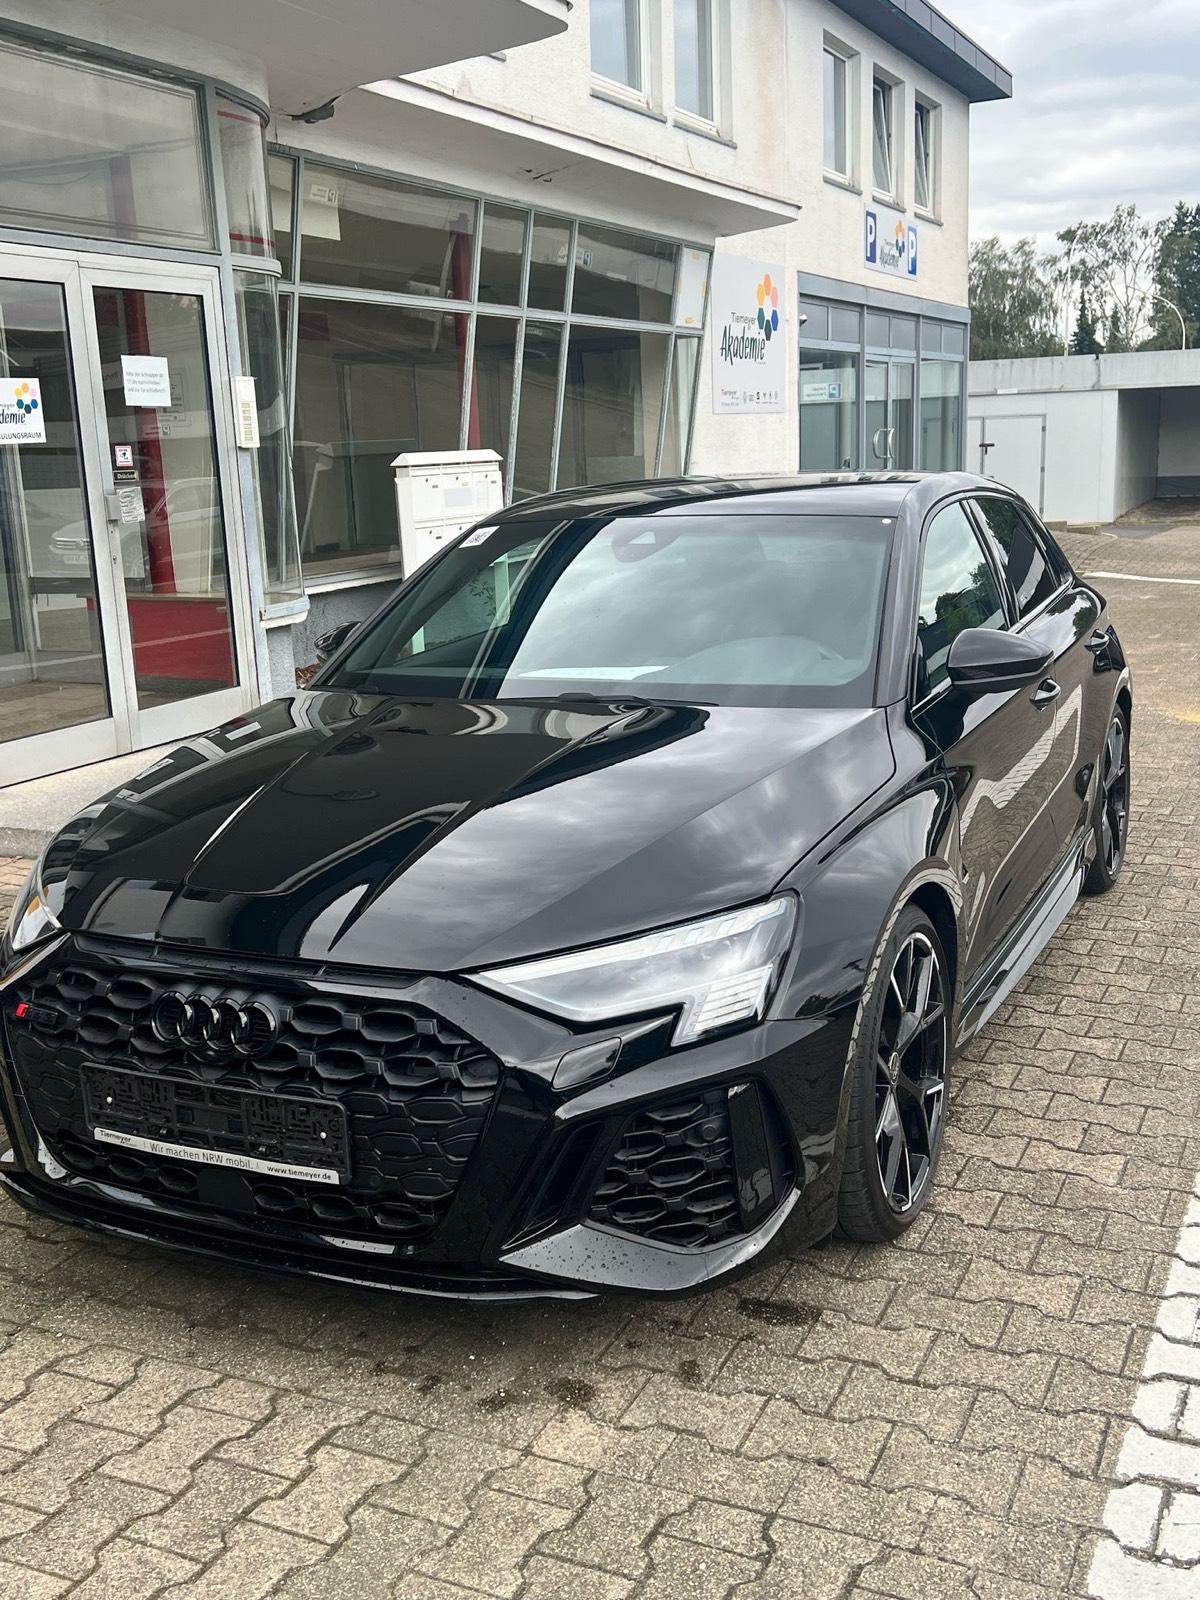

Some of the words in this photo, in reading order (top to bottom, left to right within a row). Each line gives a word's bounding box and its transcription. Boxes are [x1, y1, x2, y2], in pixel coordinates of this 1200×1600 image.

[867, 215, 876, 258] P
[908, 230, 917, 272] P
[731, 311, 756, 330] Tiemeyer
[720, 324, 765, 366] Akademie
[0, 408, 26, 424] demie
[100, 1130, 131, 1145] Tiemeyer
[150, 1143, 164, 1153] Wir
[166, 1147, 200, 1160] machen
[202, 1152, 223, 1163] NRW
[267, 1164, 331, 1181] www.tiemeyer.de
